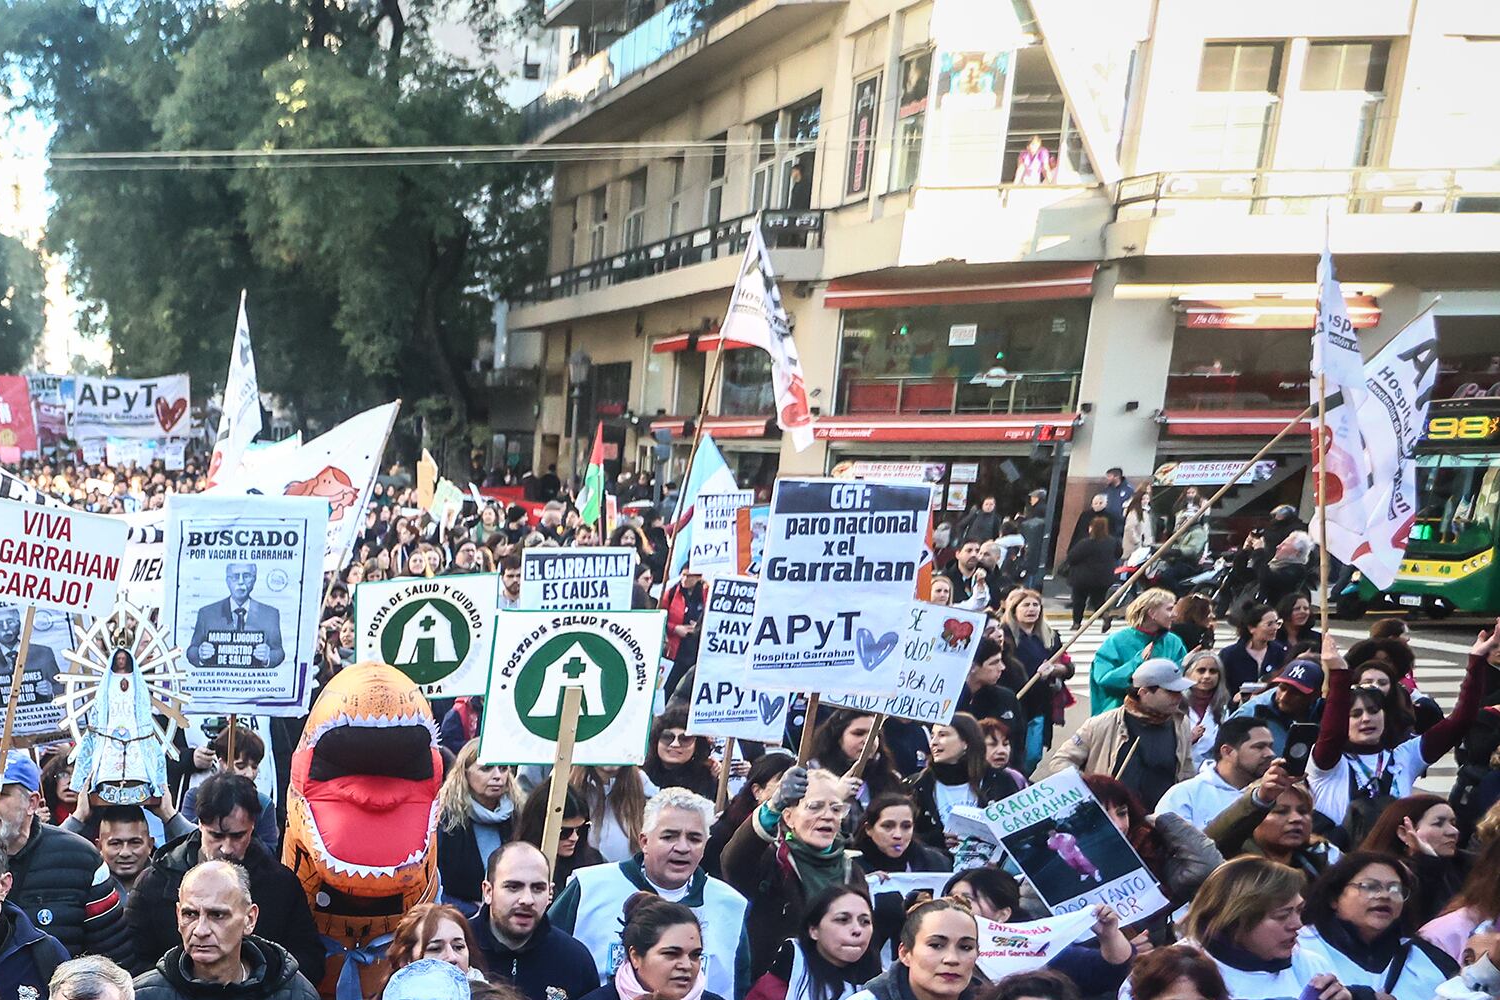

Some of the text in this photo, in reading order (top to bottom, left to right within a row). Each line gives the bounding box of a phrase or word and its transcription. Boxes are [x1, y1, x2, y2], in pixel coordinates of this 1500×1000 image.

[77, 383, 158, 413] APyT
[1427, 416, 1490, 440] 98
[1197, 463, 1247, 471] DESCUENT
[830, 484, 872, 510] CGT:
[22, 510, 72, 543] VIVA
[785, 510, 919, 540] paro nacional
[186, 530, 299, 548] BUSCADO
[693, 541, 729, 557] APyT
[822, 536, 856, 556] x el
[0, 539, 121, 582] GARRAHAN
[208, 549, 238, 560] VACIAR
[239, 550, 248, 560] EL
[525, 555, 629, 580] EL GARRAHAN
[766, 556, 915, 582] Garrahan
[542, 580, 609, 601] ES CAUSA
[714, 581, 728, 595] El
[367, 582, 483, 639] POSTA DE SALUD Y CUIDADO
[712, 596, 754, 614] de los
[207, 632, 264, 643] MARIO LUGONES
[718, 619, 753, 637] HAY
[753, 611, 861, 650] APyT
[217, 644, 253, 655] MINISTRO
[501, 636, 533, 679] POSTA
[530, 624, 548, 640] DE
[551, 615, 598, 628] SALUD
[598, 618, 610, 630] Y
[707, 639, 750, 656] SALV
[753, 649, 855, 663] Hospital Garrahan
[904, 637, 936, 662] OLO!
[217, 654, 252, 665] DE SALUD
[418, 684, 443, 695] ABA
[929, 673, 945, 695] LA
[694, 708, 758, 719] Hospital Garrahan
[985, 783, 1055, 822] GRACIAS
[1002, 786, 1084, 833] GARRAHAN
[1094, 875, 1146, 905] TANTO
[1117, 896, 1144, 921] OR
